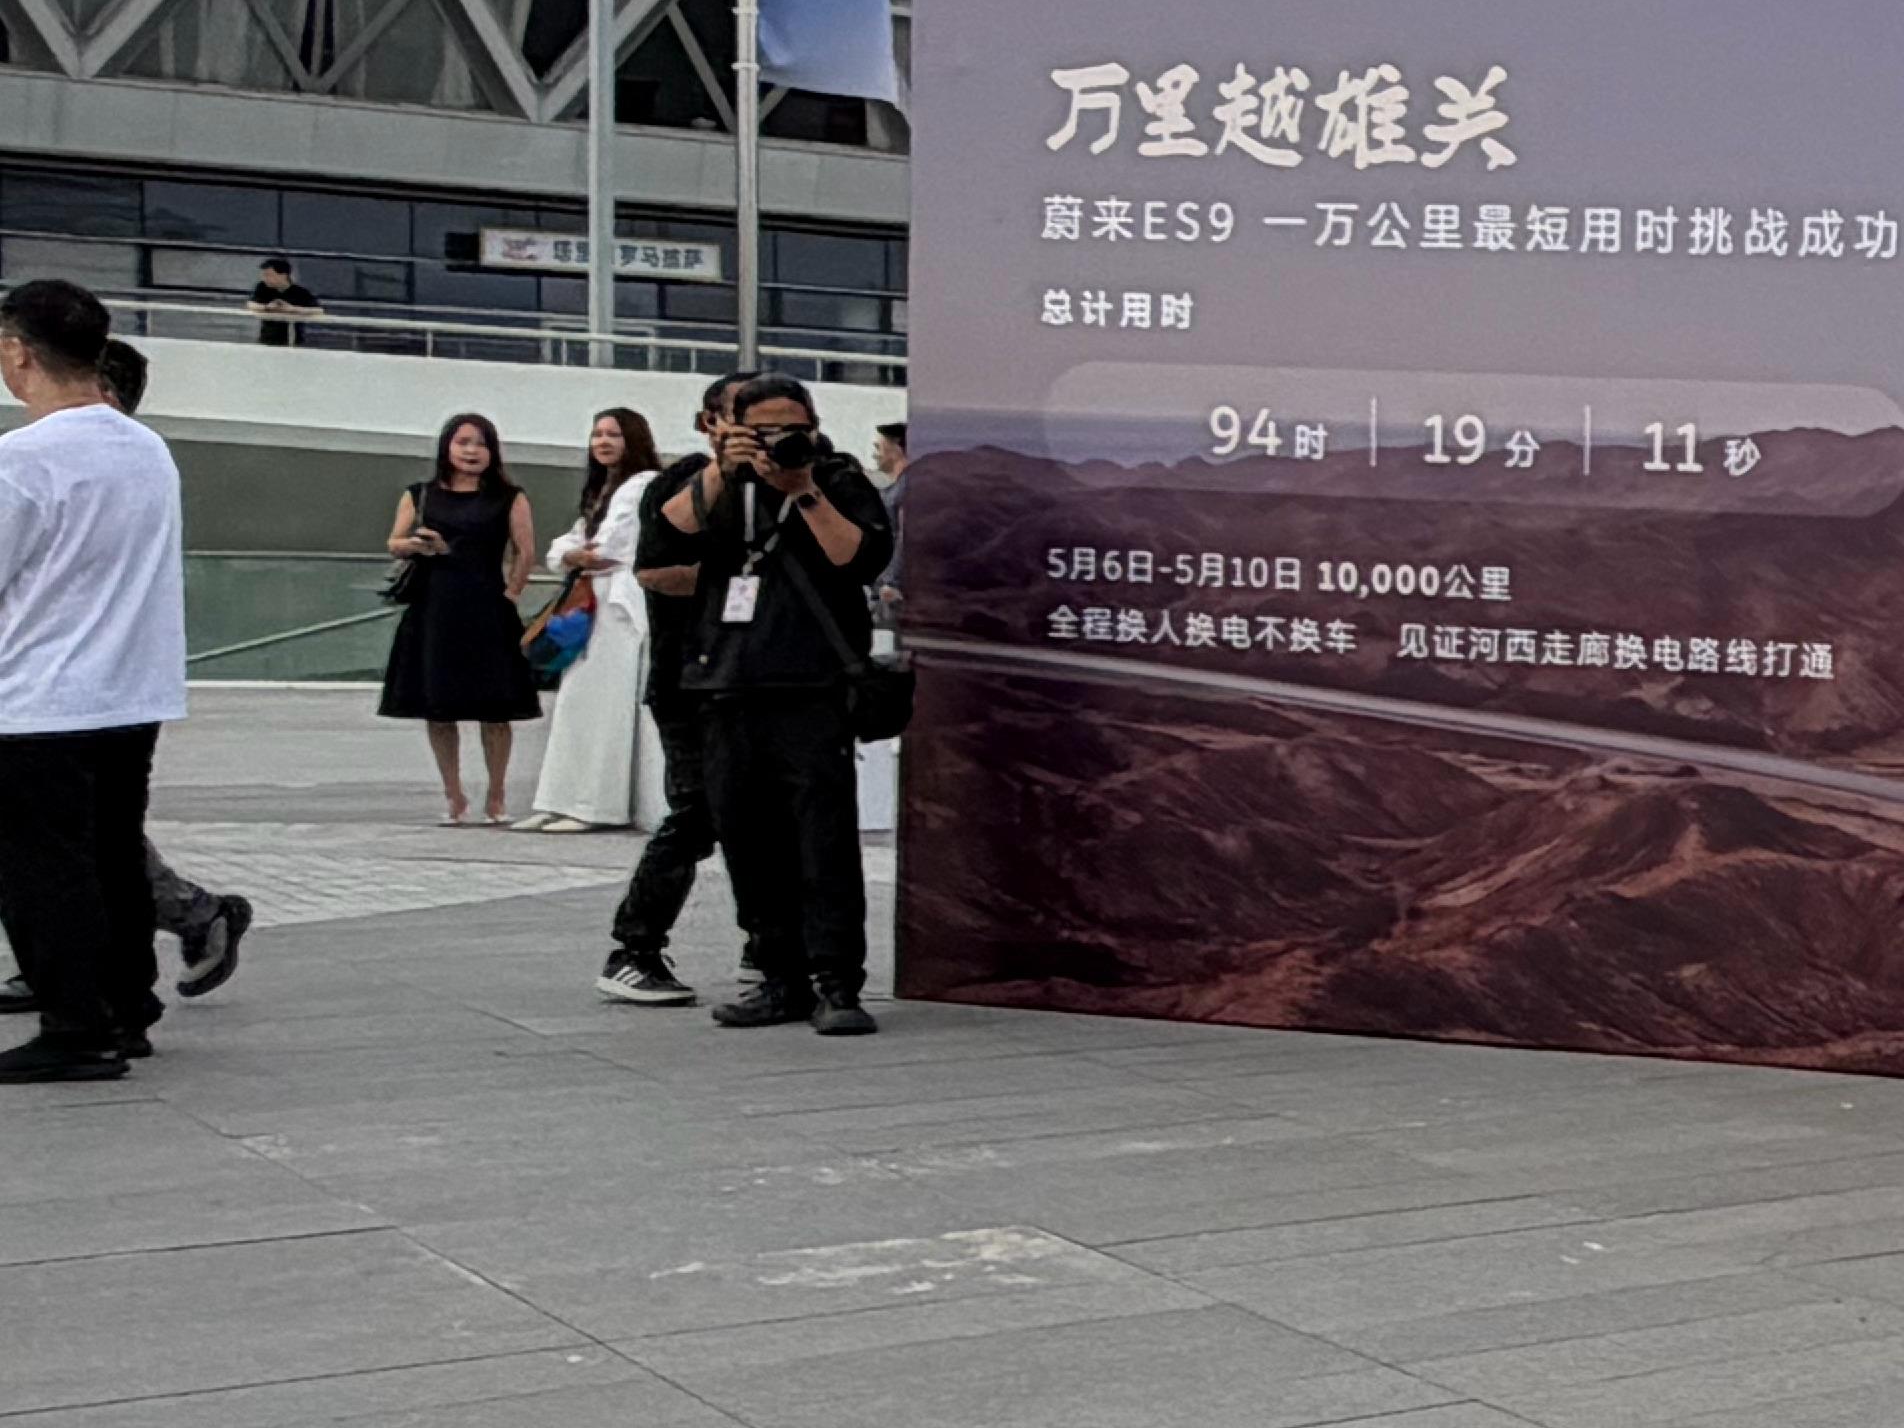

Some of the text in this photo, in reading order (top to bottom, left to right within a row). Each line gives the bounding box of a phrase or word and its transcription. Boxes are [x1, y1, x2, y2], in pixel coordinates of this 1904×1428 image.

[1046, 62, 1518, 171] 万里越雄关
[1040, 194, 1898, 259] 蔚来ES9 一万公里最短用时挑战成功
[1040, 288, 1194, 330] 总计用时
[1046, 605, 1835, 680] 全程换人换电不换车 见证河西走廊换电路线打通
